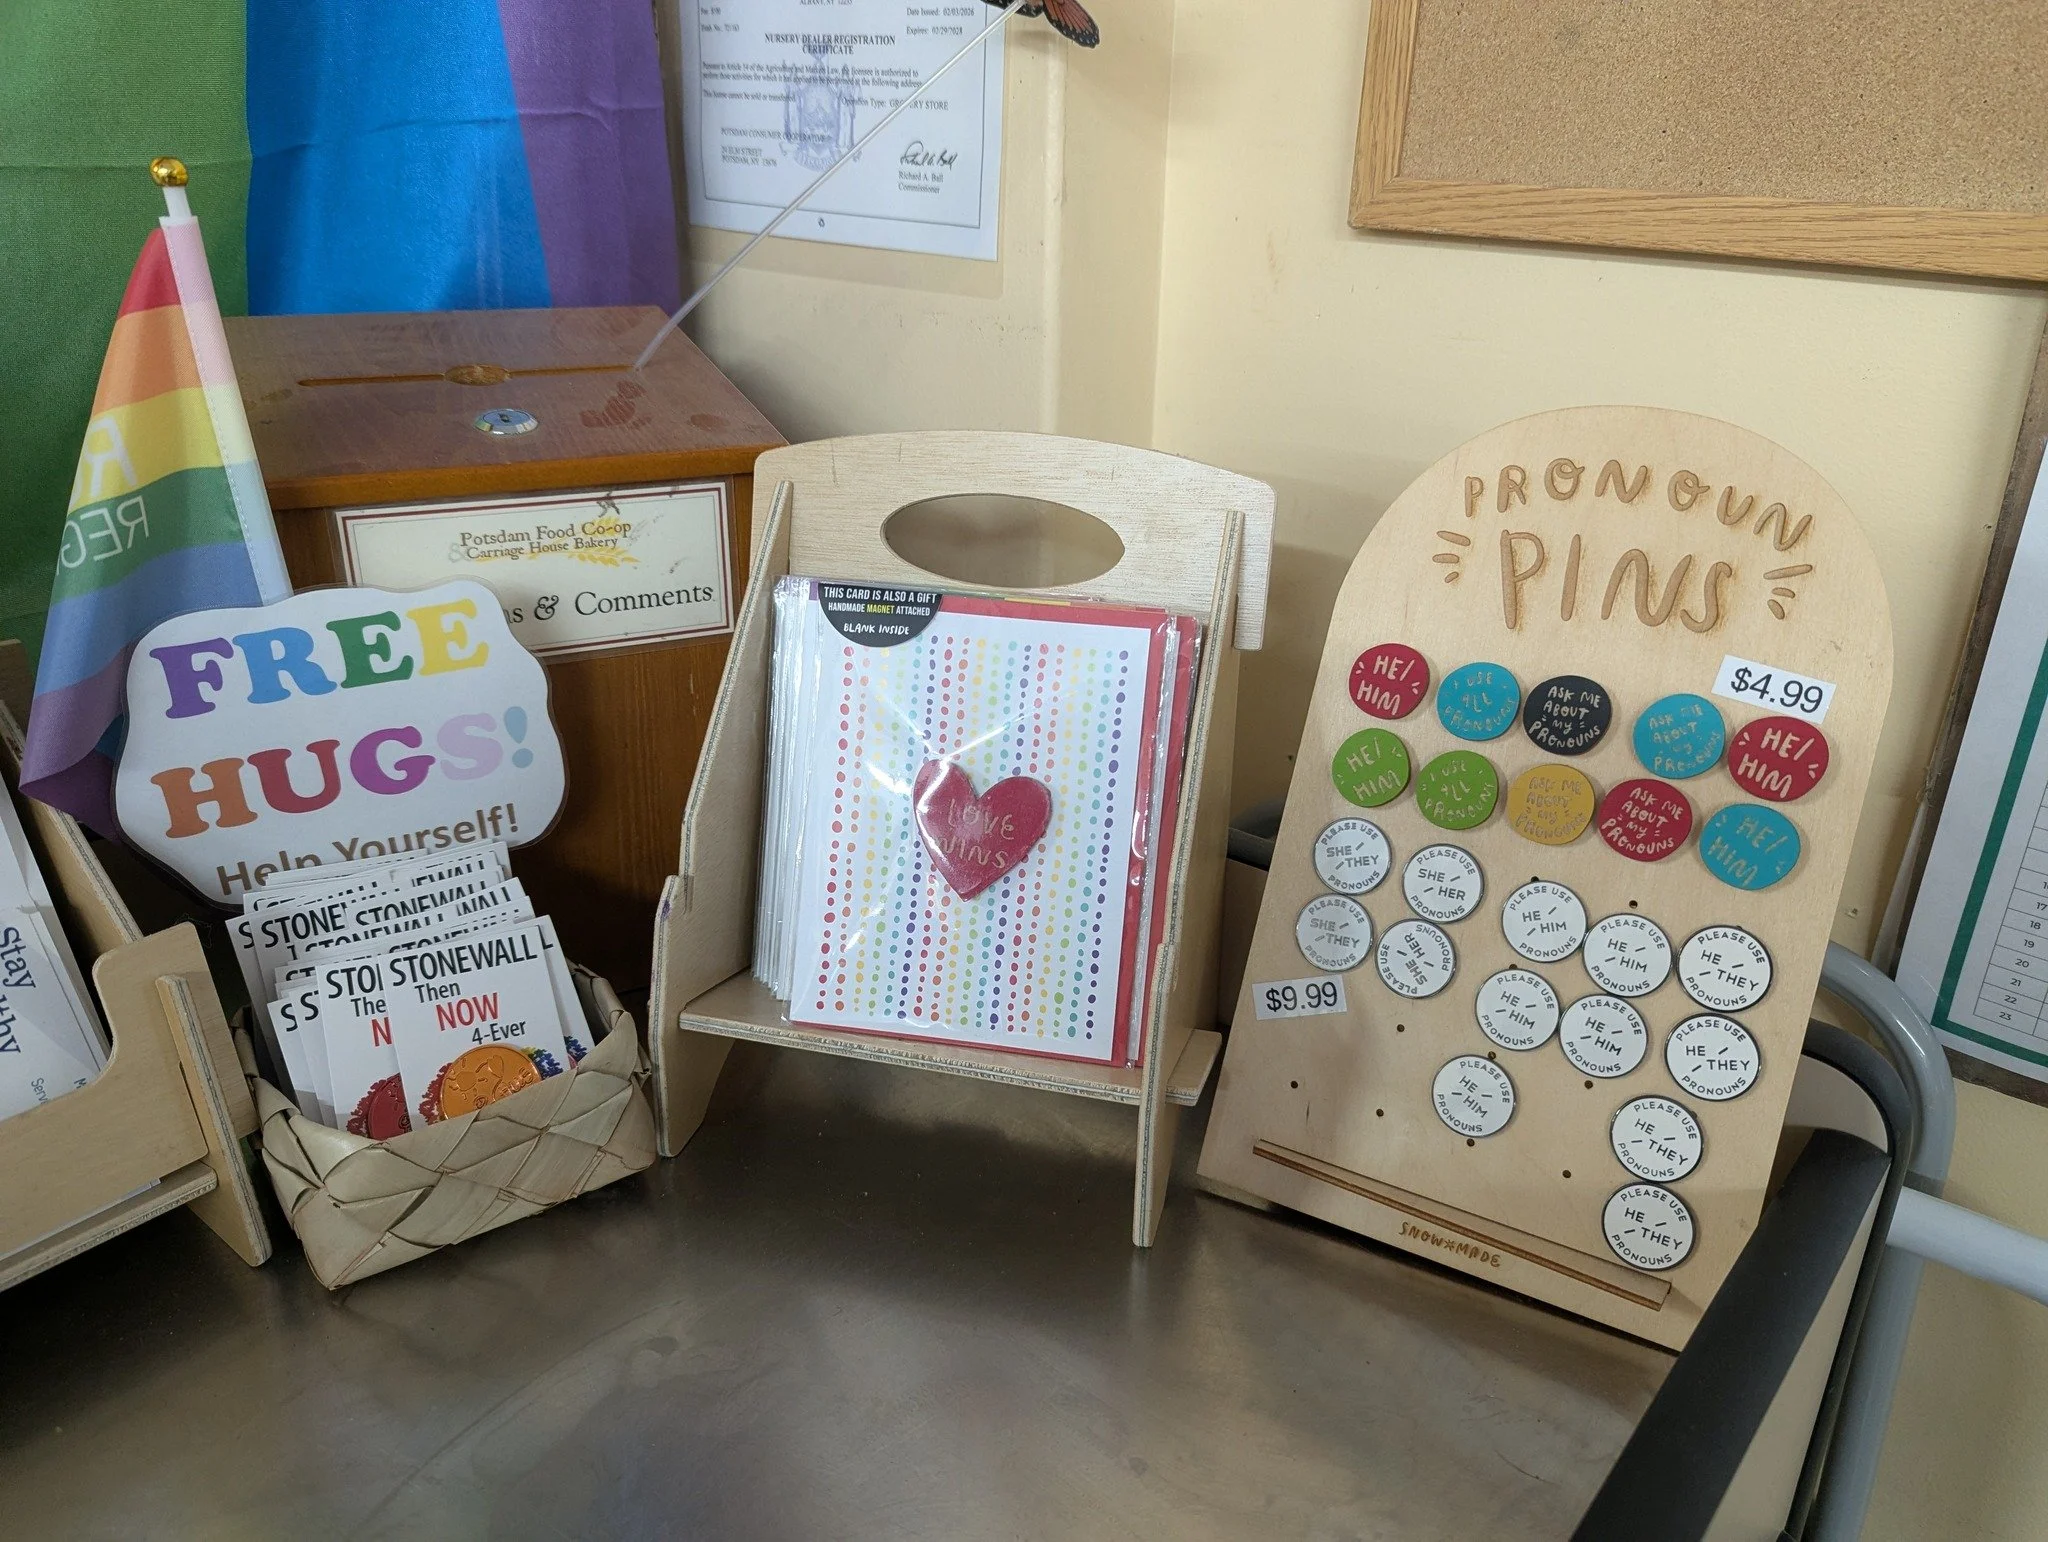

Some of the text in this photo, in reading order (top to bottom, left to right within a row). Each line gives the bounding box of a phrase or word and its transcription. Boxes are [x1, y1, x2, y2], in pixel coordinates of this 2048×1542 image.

[906, 8, 920, 16] Date
[764, 33, 896, 46] NURSERY DEALER REGISTRATION
[802, 45, 854, 54] CERTIFICATE
[925, 100, 948, 110] STORE
[898, 171, 922, 181] Richard
[898, 182, 940, 194] Commissioner
[1464, 457, 1813, 552] PRONOUN
[460, 520, 632, 547] Potsdam Food Co-op
[466, 536, 619, 561] Carriage House Bakery
[824, 586, 937, 604] THIS CARD IS ALSO A GIFT
[1500, 530, 1732, 633] PINS
[575, 583, 715, 617] Comments
[828, 602, 930, 616] HANDMADE MAGNET ATTACHED
[844, 622, 910, 635] BLANK INSIDE
[149, 597, 491, 720] FREE
[1356, 680, 1400, 716] HIM
[1548, 686, 1601, 708] ASK ME
[1730, 666, 1824, 714] $4.99
[1543, 701, 1590, 720] ABOUT
[1528, 720, 1600, 748] PRONOUNS
[150, 705, 535, 840] HUGS!
[1352, 769, 1401, 802] HIM
[1737, 753, 1793, 799] HIM
[1622, 800, 1668, 828] ABOUT
[1630, 787, 1684, 820] ASK ME
[332, 803, 520, 863] Yourself!
[948, 798, 1015, 840] LOVE
[1321, 822, 1379, 846] PLEASE USE
[1601, 818, 1674, 854] PRONOUNS
[1416, 850, 1476, 876] PLEASE USE
[1708, 836, 1757, 887] HIM
[1328, 870, 1381, 890] PRONOUNS
[1308, 899, 1365, 924] PLEASE USE
[1410, 895, 1465, 919] PRONOUNS
[1509, 885, 1572, 911] PLEASE USE
[2036, 902, 2048, 912] 17
[1600, 920, 1666, 950] PLEASE USE
[2030, 920, 2042, 930] 18
[0, 926, 37, 989] Stay
[1305, 944, 1356, 967] PRONOUNS
[1415, 924, 1450, 972] PRONOUNS
[1518, 936, 1578, 958] PRONOUNS
[1698, 930, 1766, 964] PLEASE USE
[2024, 938, 2035, 949] 19
[389, 934, 538, 987] STONEWALL
[1380, 943, 1418, 994] PLEASE USE
[2014, 958, 2030, 968] 20
[414, 980, 461, 1004] Then
[1497, 974, 1555, 1010] PLEASE USE
[1591, 965, 1650, 993] PRONOUNS
[1686, 976, 1748, 1007] PRONOUNS
[2010, 978, 2022, 987] 21
[350, 997, 387, 1018] The
[1265, 980, 1338, 1013] $9.99
[2004, 994, 2017, 1004] 22
[436, 992, 501, 1032] NOW
[1581, 999, 1643, 1036] PLEASE USE
[1998, 1011, 2012, 1021] 23
[472, 1018, 527, 1045] 4-Ever
[1481, 1014, 1535, 1046] PRONOUNS
[1676, 1019, 1746, 1043] PLEASE USE
[1566, 1040, 1622, 1073] PRONOUNS
[1459, 1060, 1510, 1104] PLEASE USE
[1682, 1074, 1746, 1096] PRONOUNS
[1436, 1093, 1483, 1133] PRONOUNS
[1633, 1102, 1698, 1140] PLEASE USE
[1618, 1142, 1675, 1178] PRONOUNS
[1620, 1188, 1688, 1223] PLEASE USE
[1612, 1234, 1672, 1266] PRONOUNS
